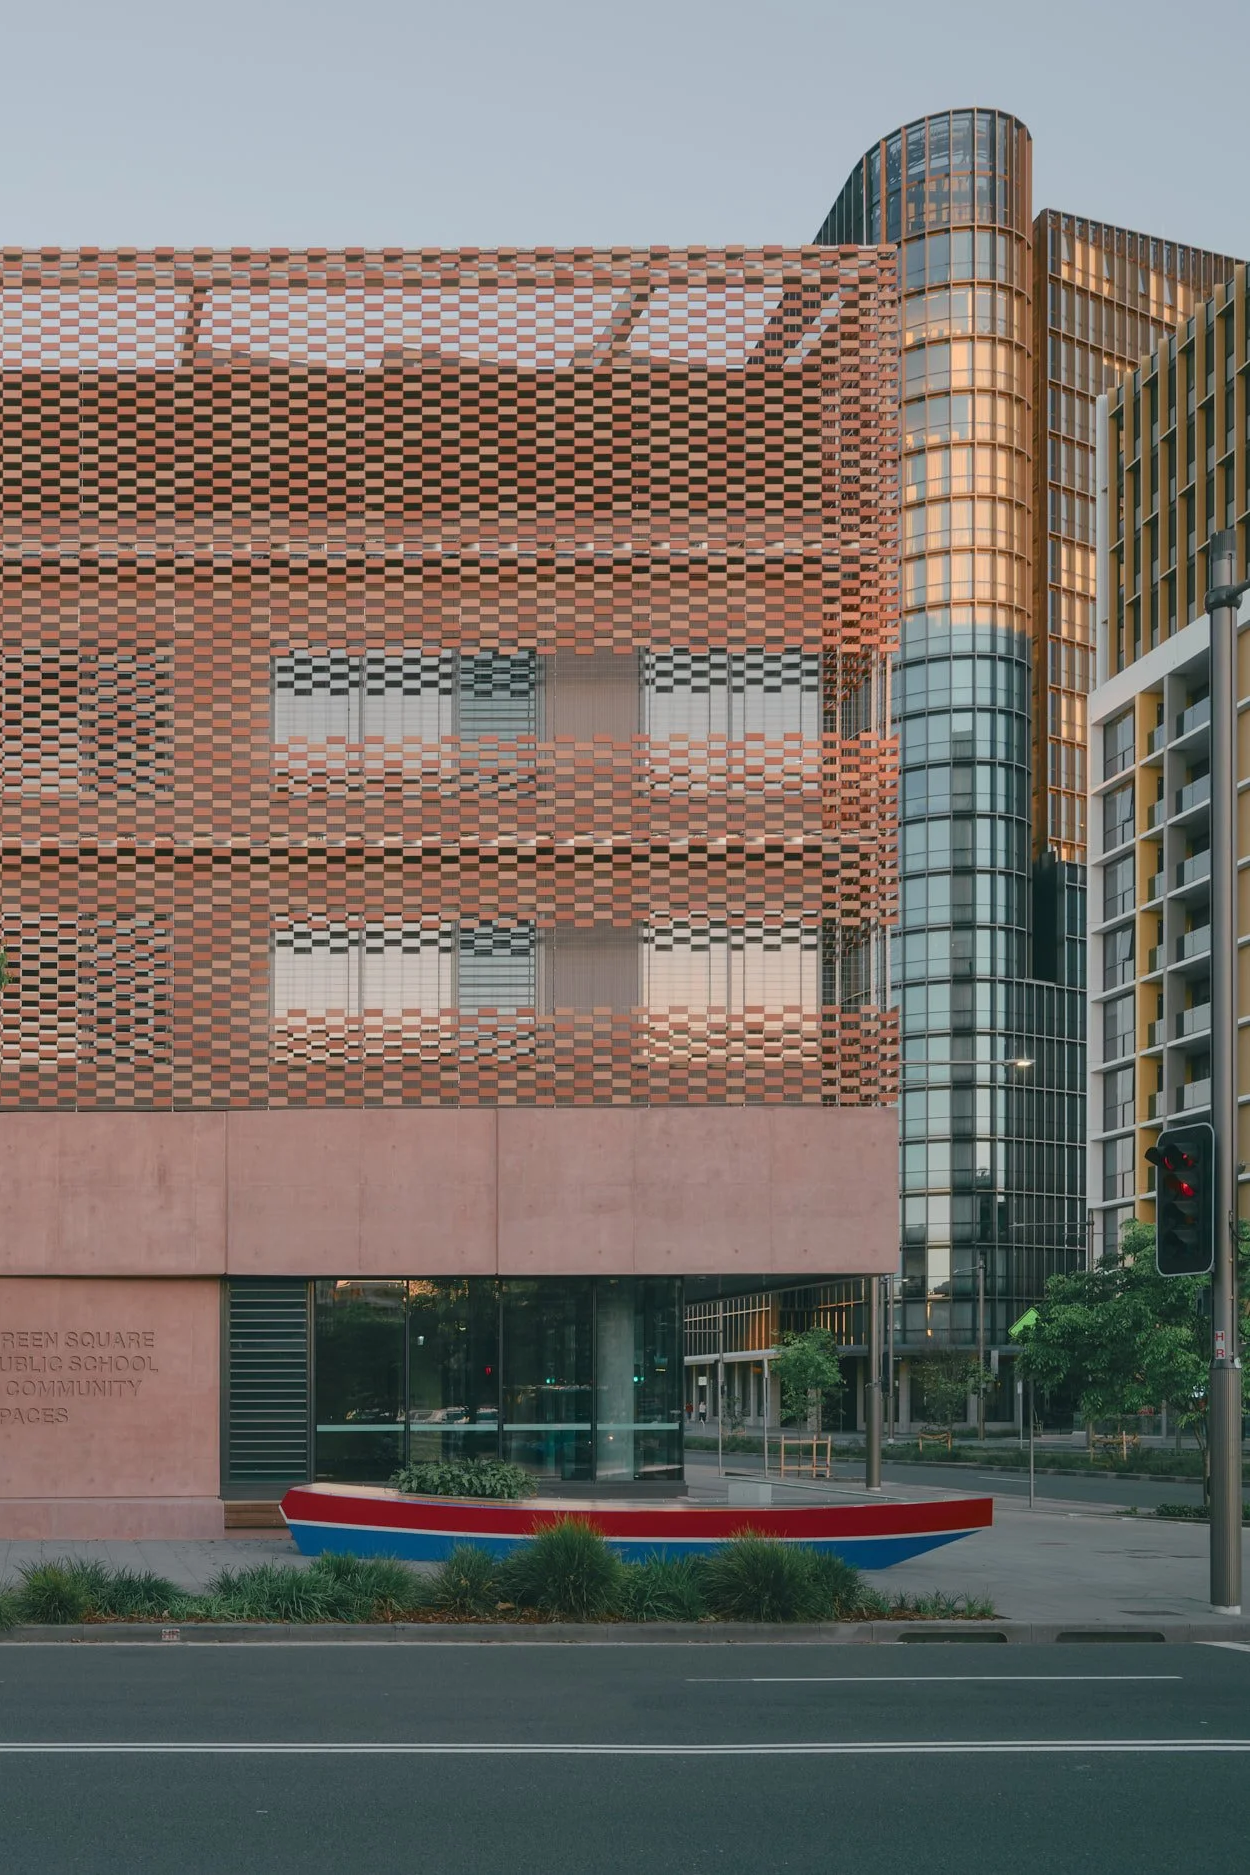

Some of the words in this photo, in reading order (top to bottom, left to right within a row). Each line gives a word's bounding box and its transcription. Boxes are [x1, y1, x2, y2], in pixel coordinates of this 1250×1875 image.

[64, 1331, 155, 1349] SQUARE
[68, 1355, 158, 1373] SCHOOL
[6, 1380, 142, 1398] COMMUNITY
